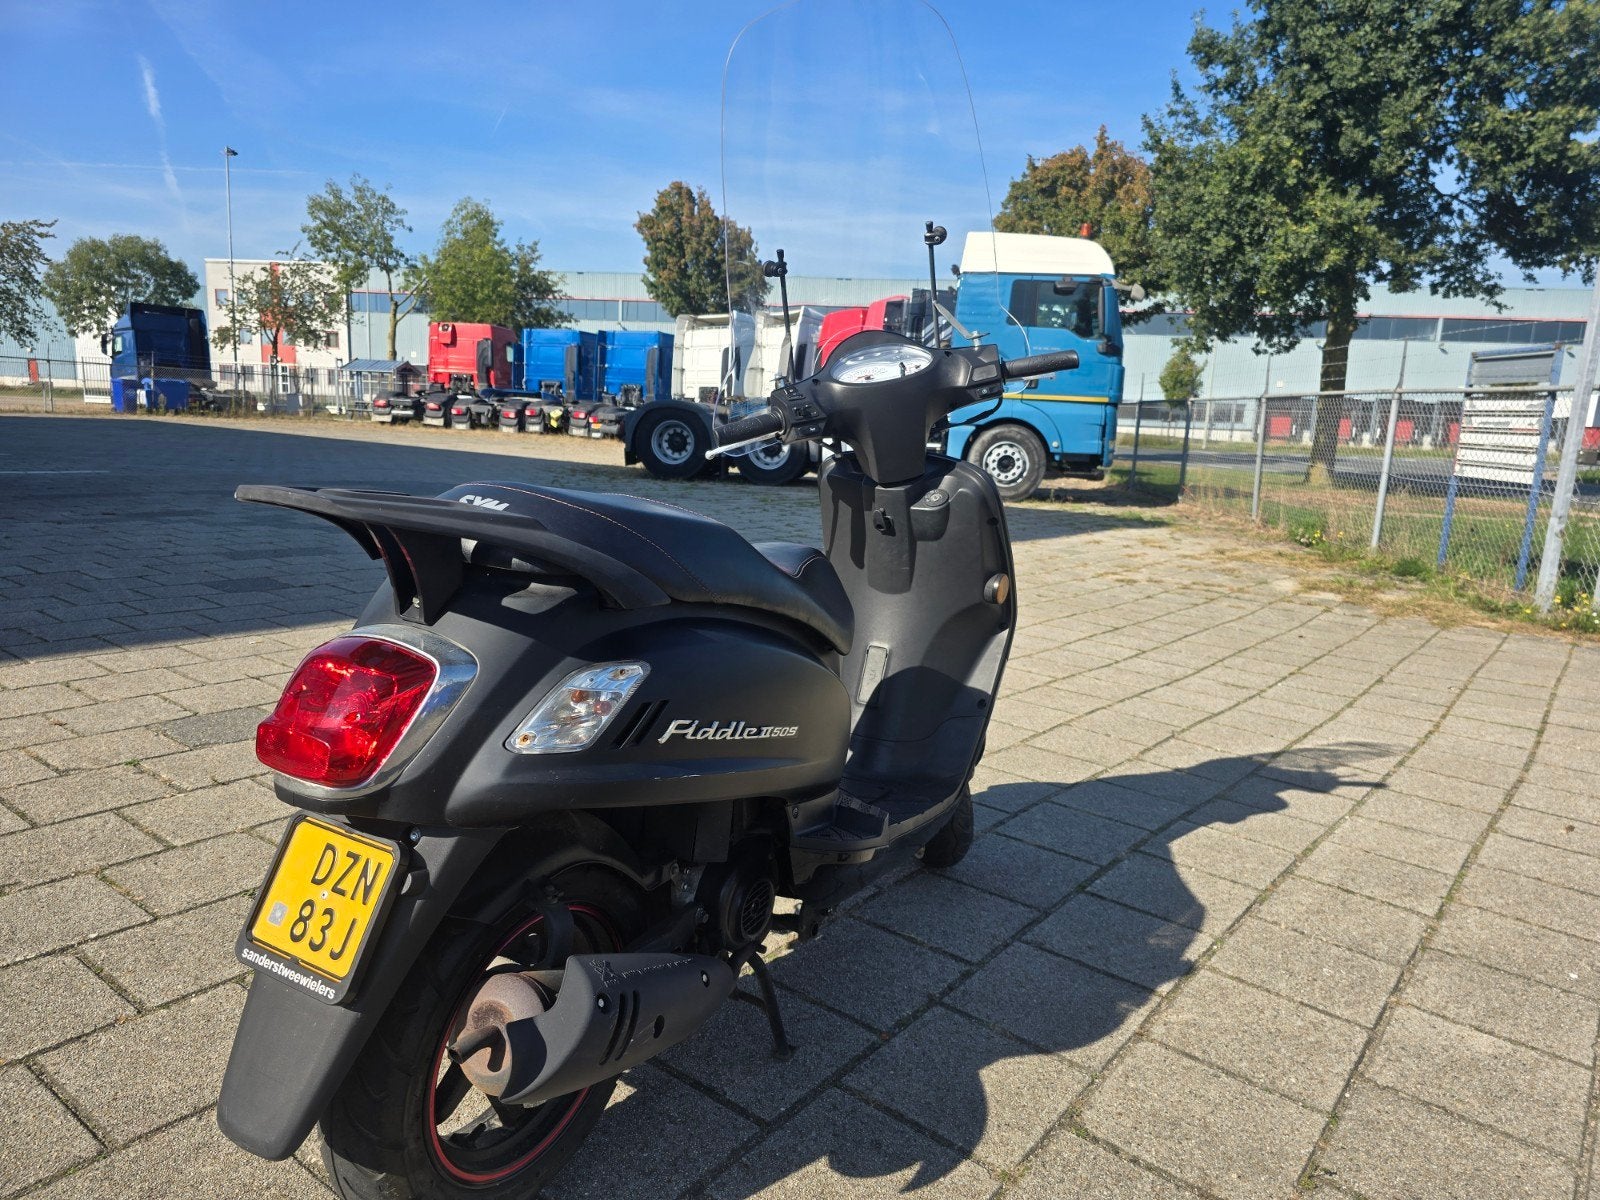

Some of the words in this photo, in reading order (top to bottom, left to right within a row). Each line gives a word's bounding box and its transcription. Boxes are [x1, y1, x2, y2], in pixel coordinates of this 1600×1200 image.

[657, 719, 761, 745] Fiddle
[310, 842, 383, 906] DZN
[289, 898, 358, 961] 83J
[241, 947, 336, 1000] sanderstweewielers
